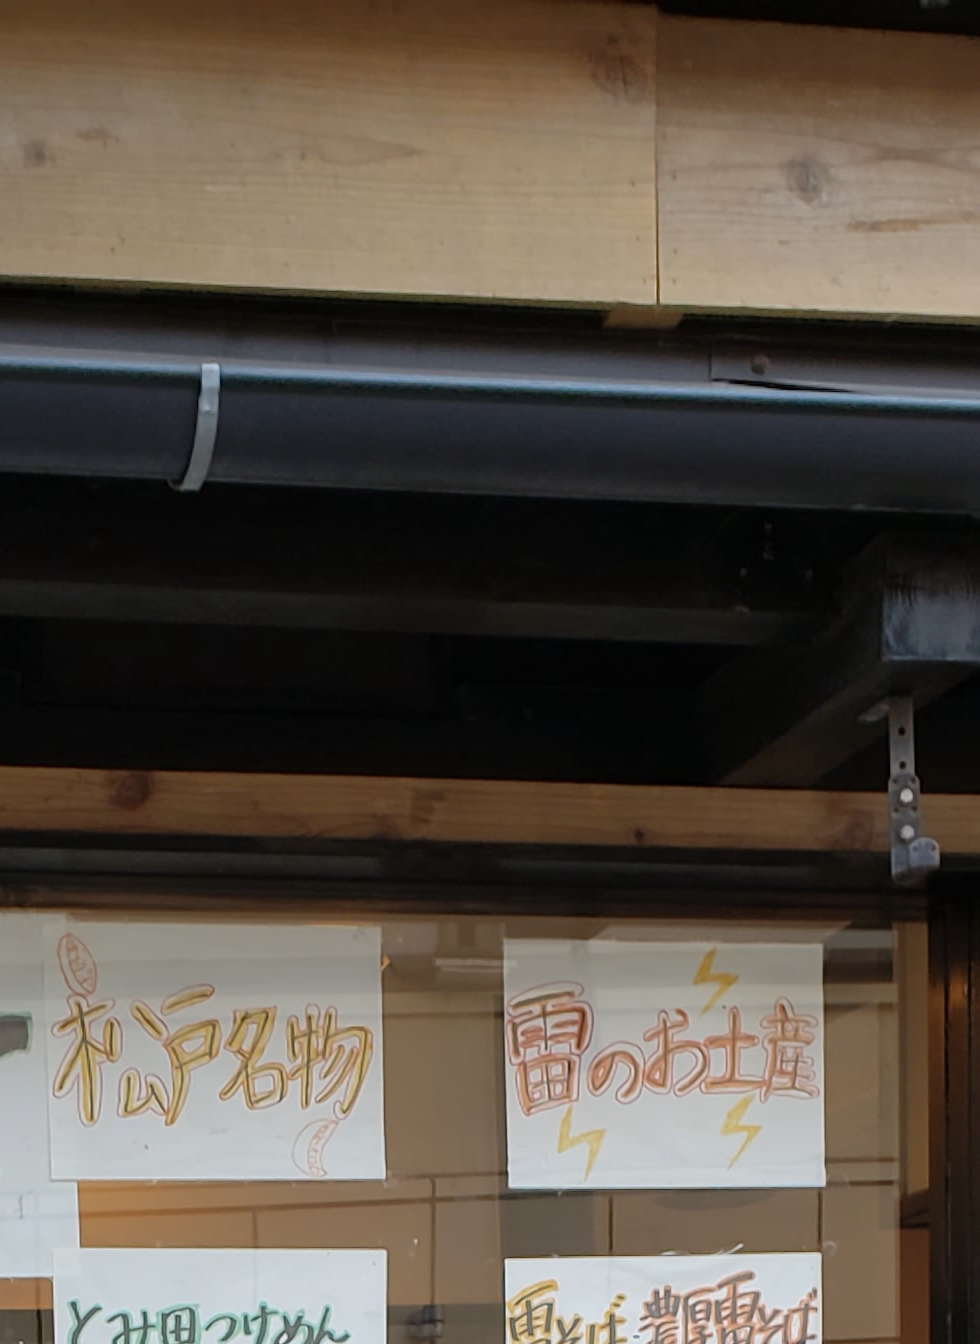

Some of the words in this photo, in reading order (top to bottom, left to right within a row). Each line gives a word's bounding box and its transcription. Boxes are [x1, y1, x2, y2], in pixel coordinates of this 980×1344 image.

[52, 984, 373, 1127] 松戸名物
[507, 981, 819, 1116] 雷のお土産
